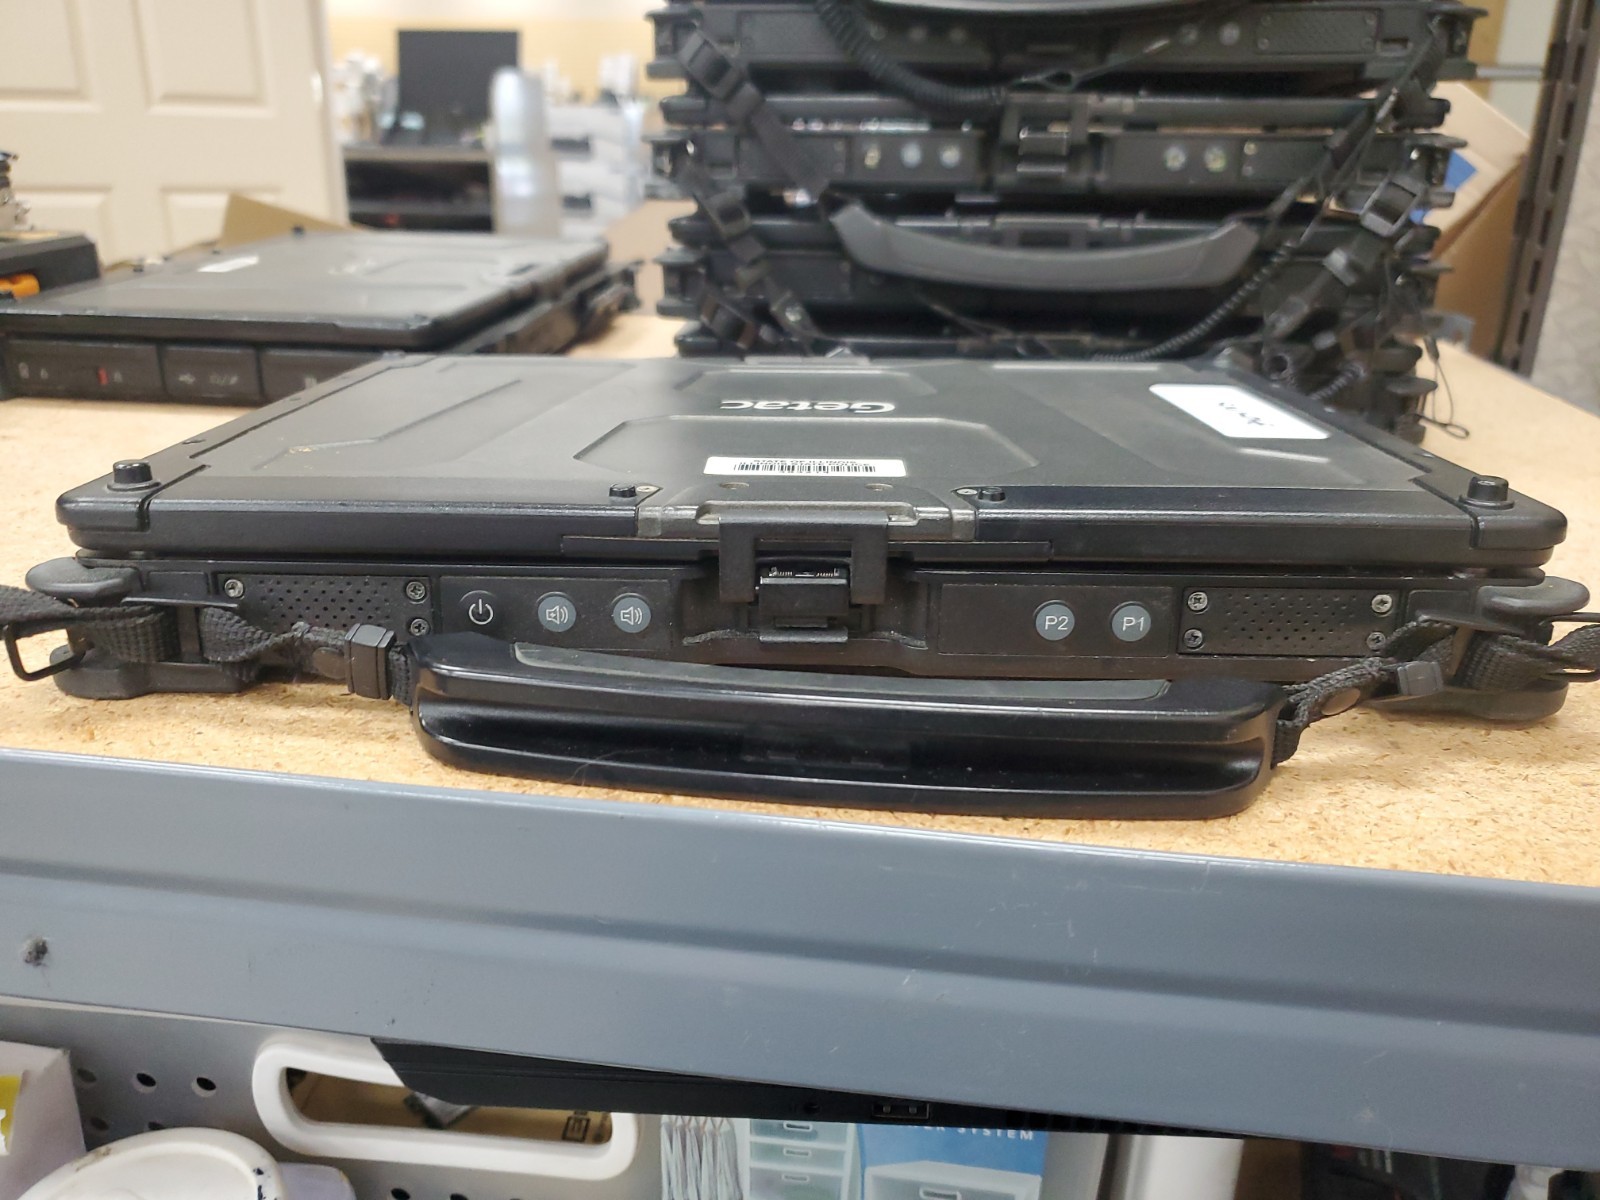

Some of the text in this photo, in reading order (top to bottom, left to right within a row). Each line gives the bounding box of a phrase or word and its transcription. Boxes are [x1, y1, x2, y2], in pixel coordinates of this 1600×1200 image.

[720, 401, 896, 413] Getac
[1045, 615, 1069, 630] P2
[1122, 616, 1145, 632] P1
